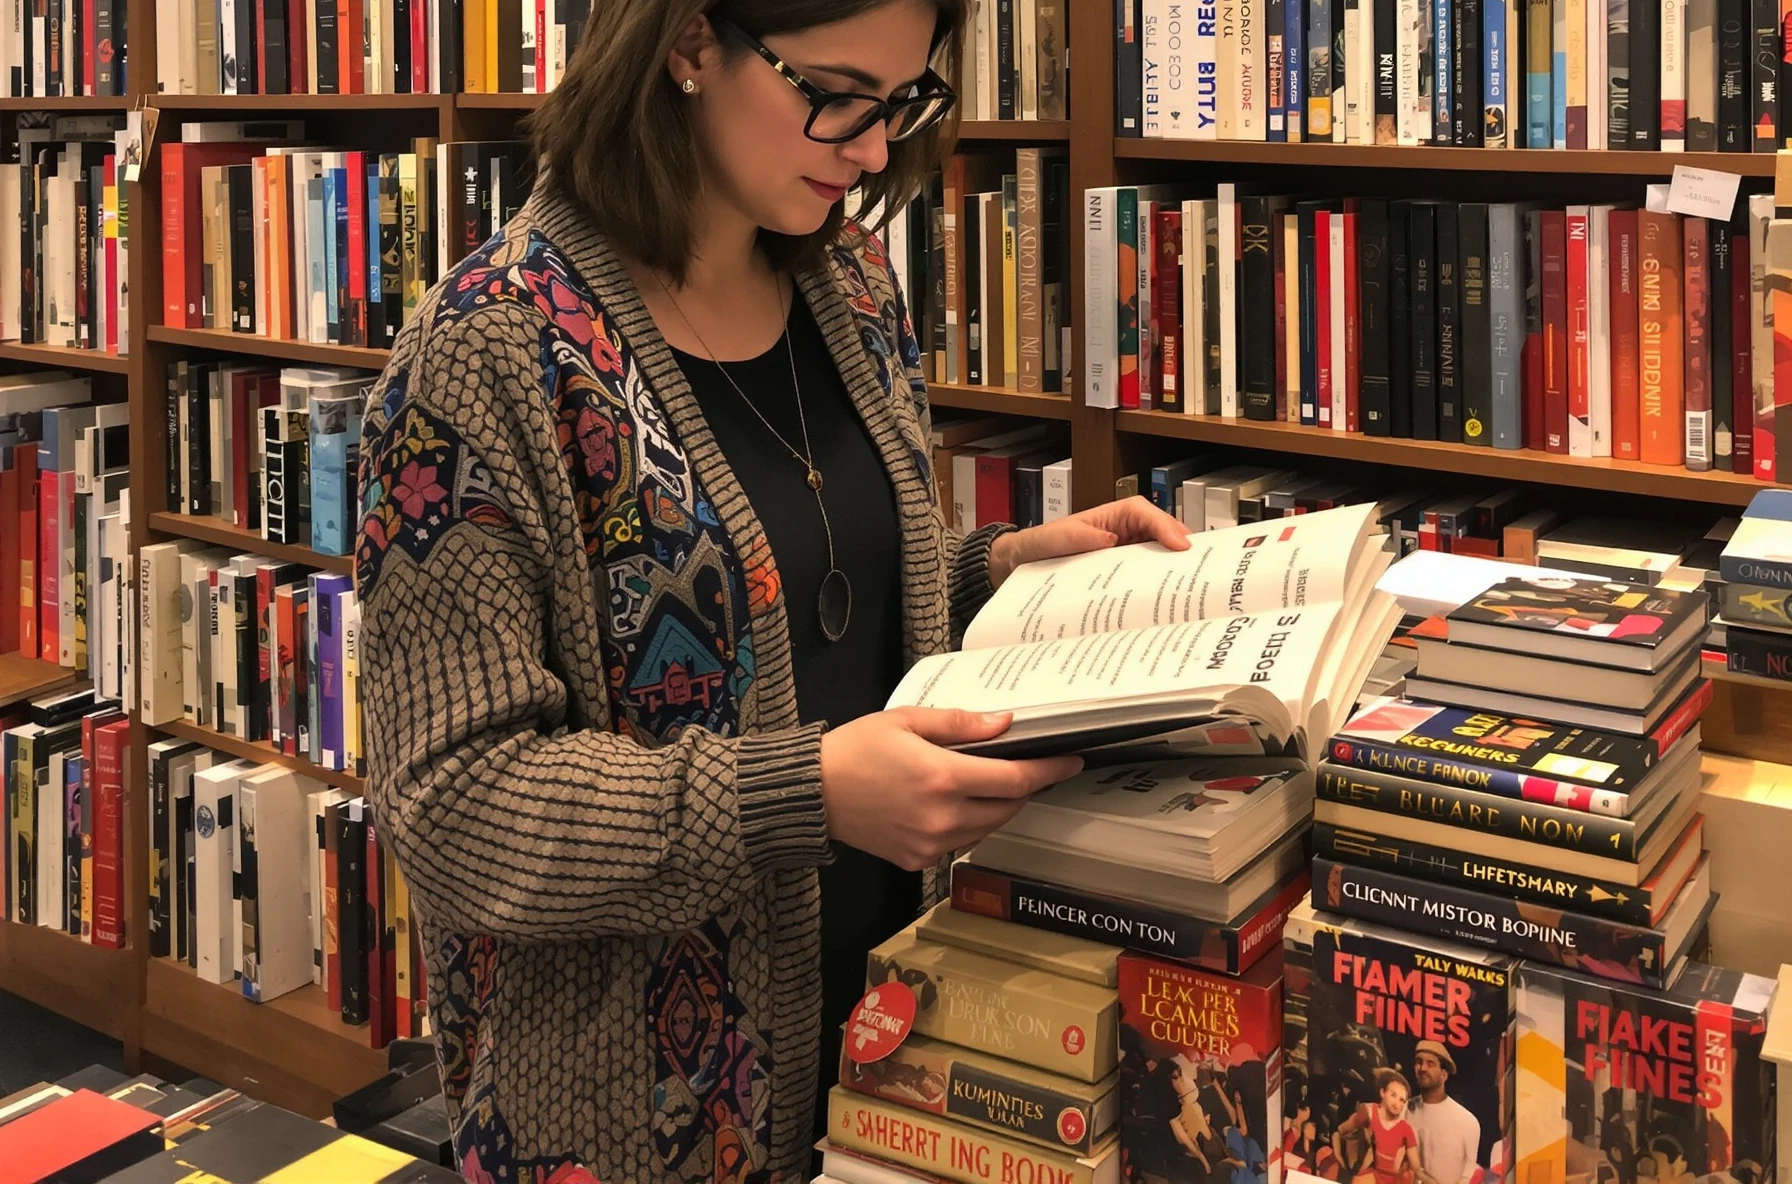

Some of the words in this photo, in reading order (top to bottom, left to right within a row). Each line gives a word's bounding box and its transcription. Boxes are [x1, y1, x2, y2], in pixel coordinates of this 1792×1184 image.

[1422, 899, 1497, 931] MISTOR
[1203, 992, 1237, 1014] PER
[950, 1136, 991, 1179] ING
